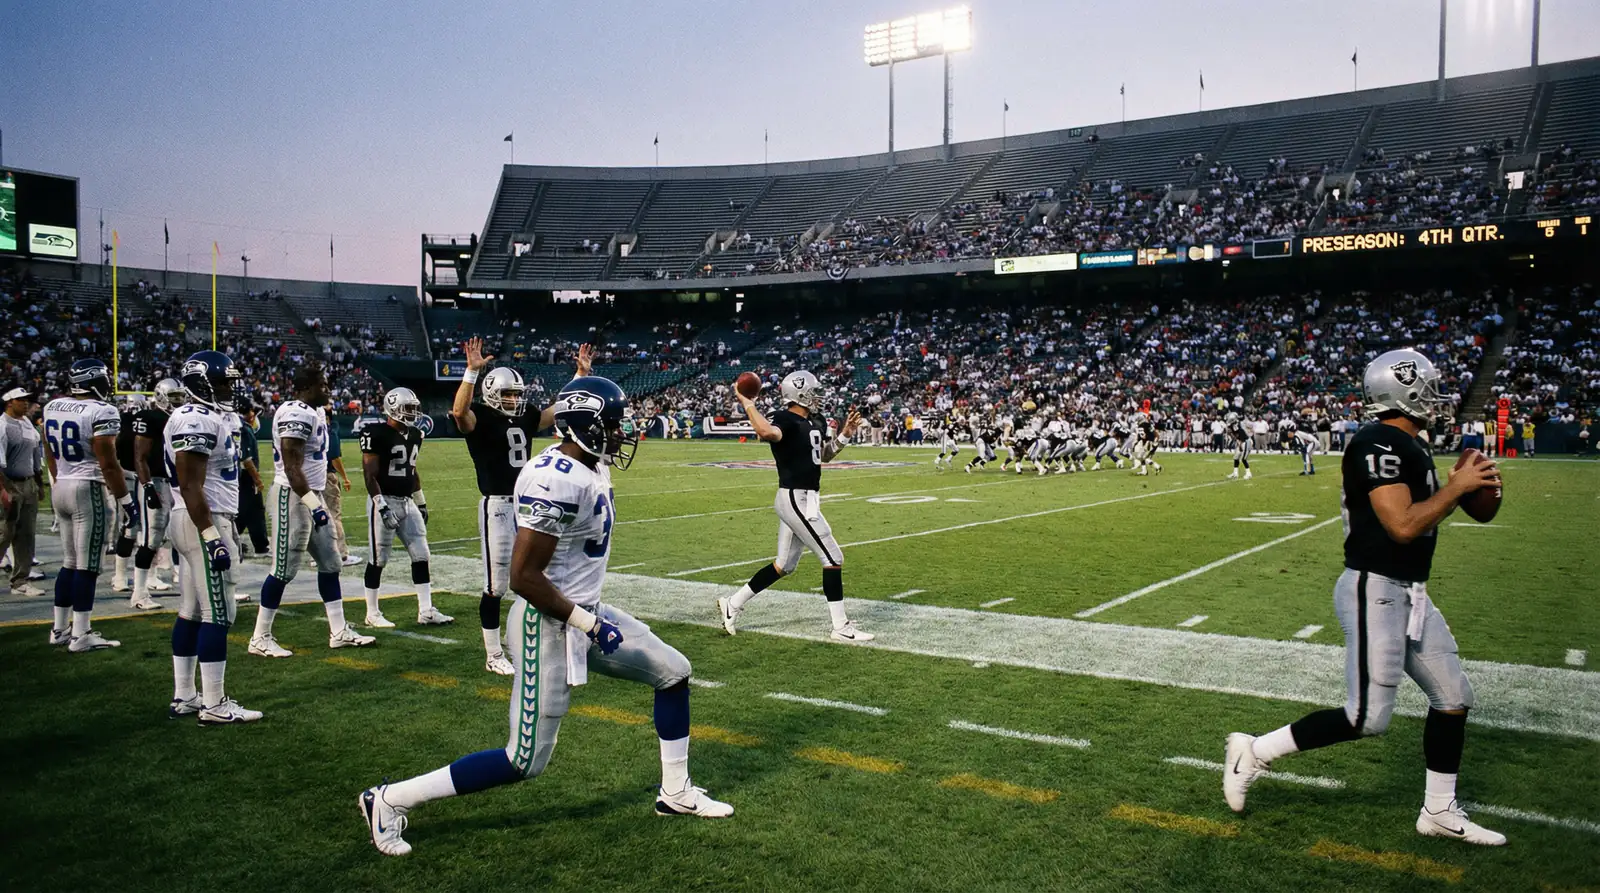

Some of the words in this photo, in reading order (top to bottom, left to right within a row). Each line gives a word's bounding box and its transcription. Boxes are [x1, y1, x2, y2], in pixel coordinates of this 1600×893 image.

[1303, 232, 1405, 253] PRESEASON:
[1418, 228, 1453, 245] 4TH
[1462, 224, 1504, 243] QTR.
[46, 418, 85, 462] 68
[506, 427, 528, 468] 8
[809, 429, 822, 466] 8
[534, 455, 574, 474] 38
[1365, 454, 1402, 480] 16
[583, 487, 616, 559] 3
